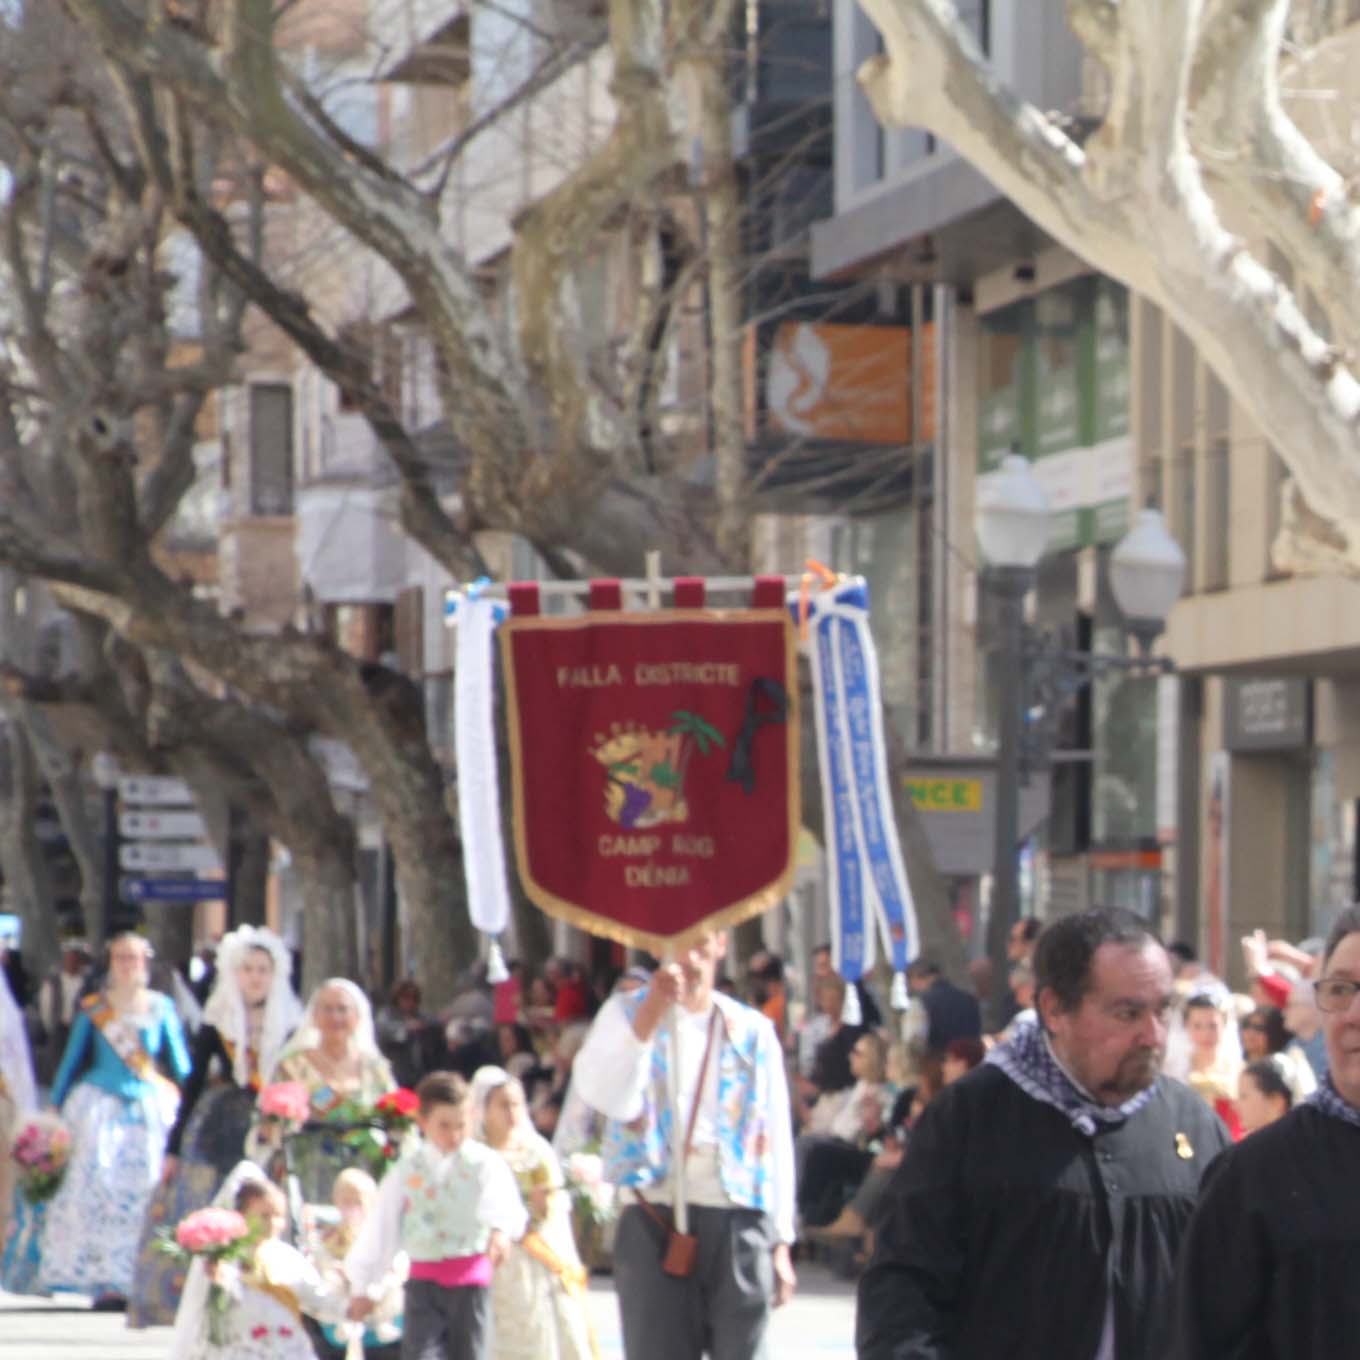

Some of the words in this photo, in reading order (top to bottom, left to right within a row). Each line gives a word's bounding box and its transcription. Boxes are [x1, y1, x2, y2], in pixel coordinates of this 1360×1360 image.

[556, 664, 623, 689] FALLA
[634, 660, 742, 687] DISTRICTE
[597, 833, 661, 858] CAMP
[624, 859, 691, 888] DÉNIA
